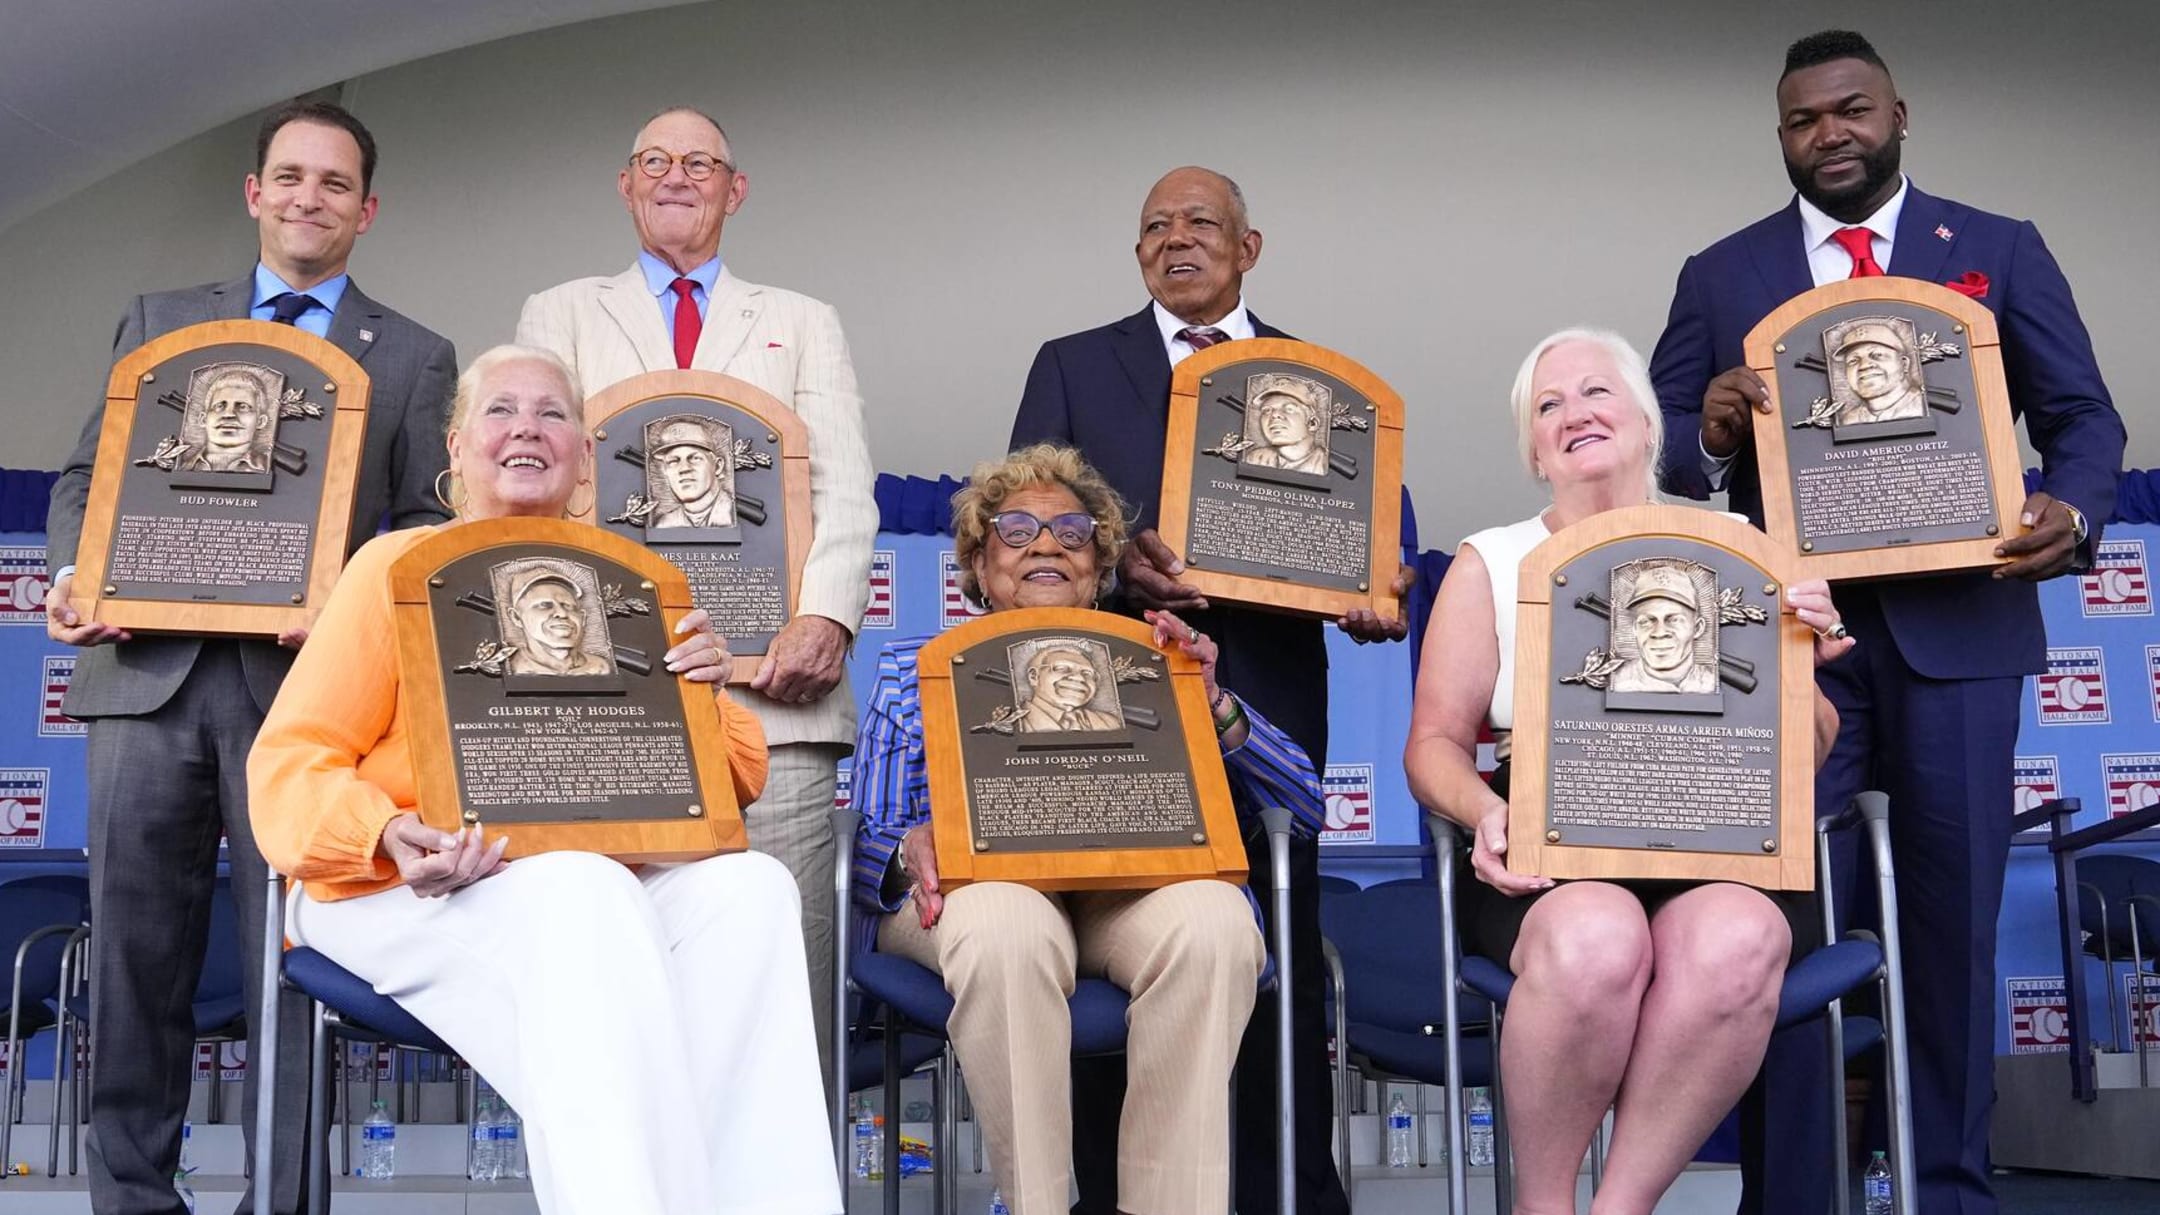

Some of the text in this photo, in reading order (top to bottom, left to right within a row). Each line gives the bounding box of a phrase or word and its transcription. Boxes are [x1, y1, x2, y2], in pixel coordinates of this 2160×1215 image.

[1825, 441, 1948, 460] DAVID AMERICO ORTIZ
[1800, 464, 1845, 474] MINNESOTA,
[1211, 480, 1354, 509] TONY PEDRO OLIVA LOPEZ
[1242, 492, 1282, 503] MINNESOTA,
[209, 498, 257, 507] FOWLER
[2103, 544, 2140, 552] IONAL
[2097, 560, 2142, 568] SEBALL
[2088, 604, 2149, 612] HALL OF FAME
[488, 706, 644, 715] GILBERT RAY HODGES
[2044, 711, 2106, 720] HALL OF FAME
[1554, 720, 1773, 738] SATURNINO ORESTES ARMAS ARRIETA MIÑOSO
[1044, 755, 1097, 764] JORDAN
[2107, 756, 2160, 766] NATIONA
[2016, 761, 2052, 769] IONAL
[1326, 784, 1368, 792] EBALL
[1320, 831, 1371, 840] LL OF FAME
